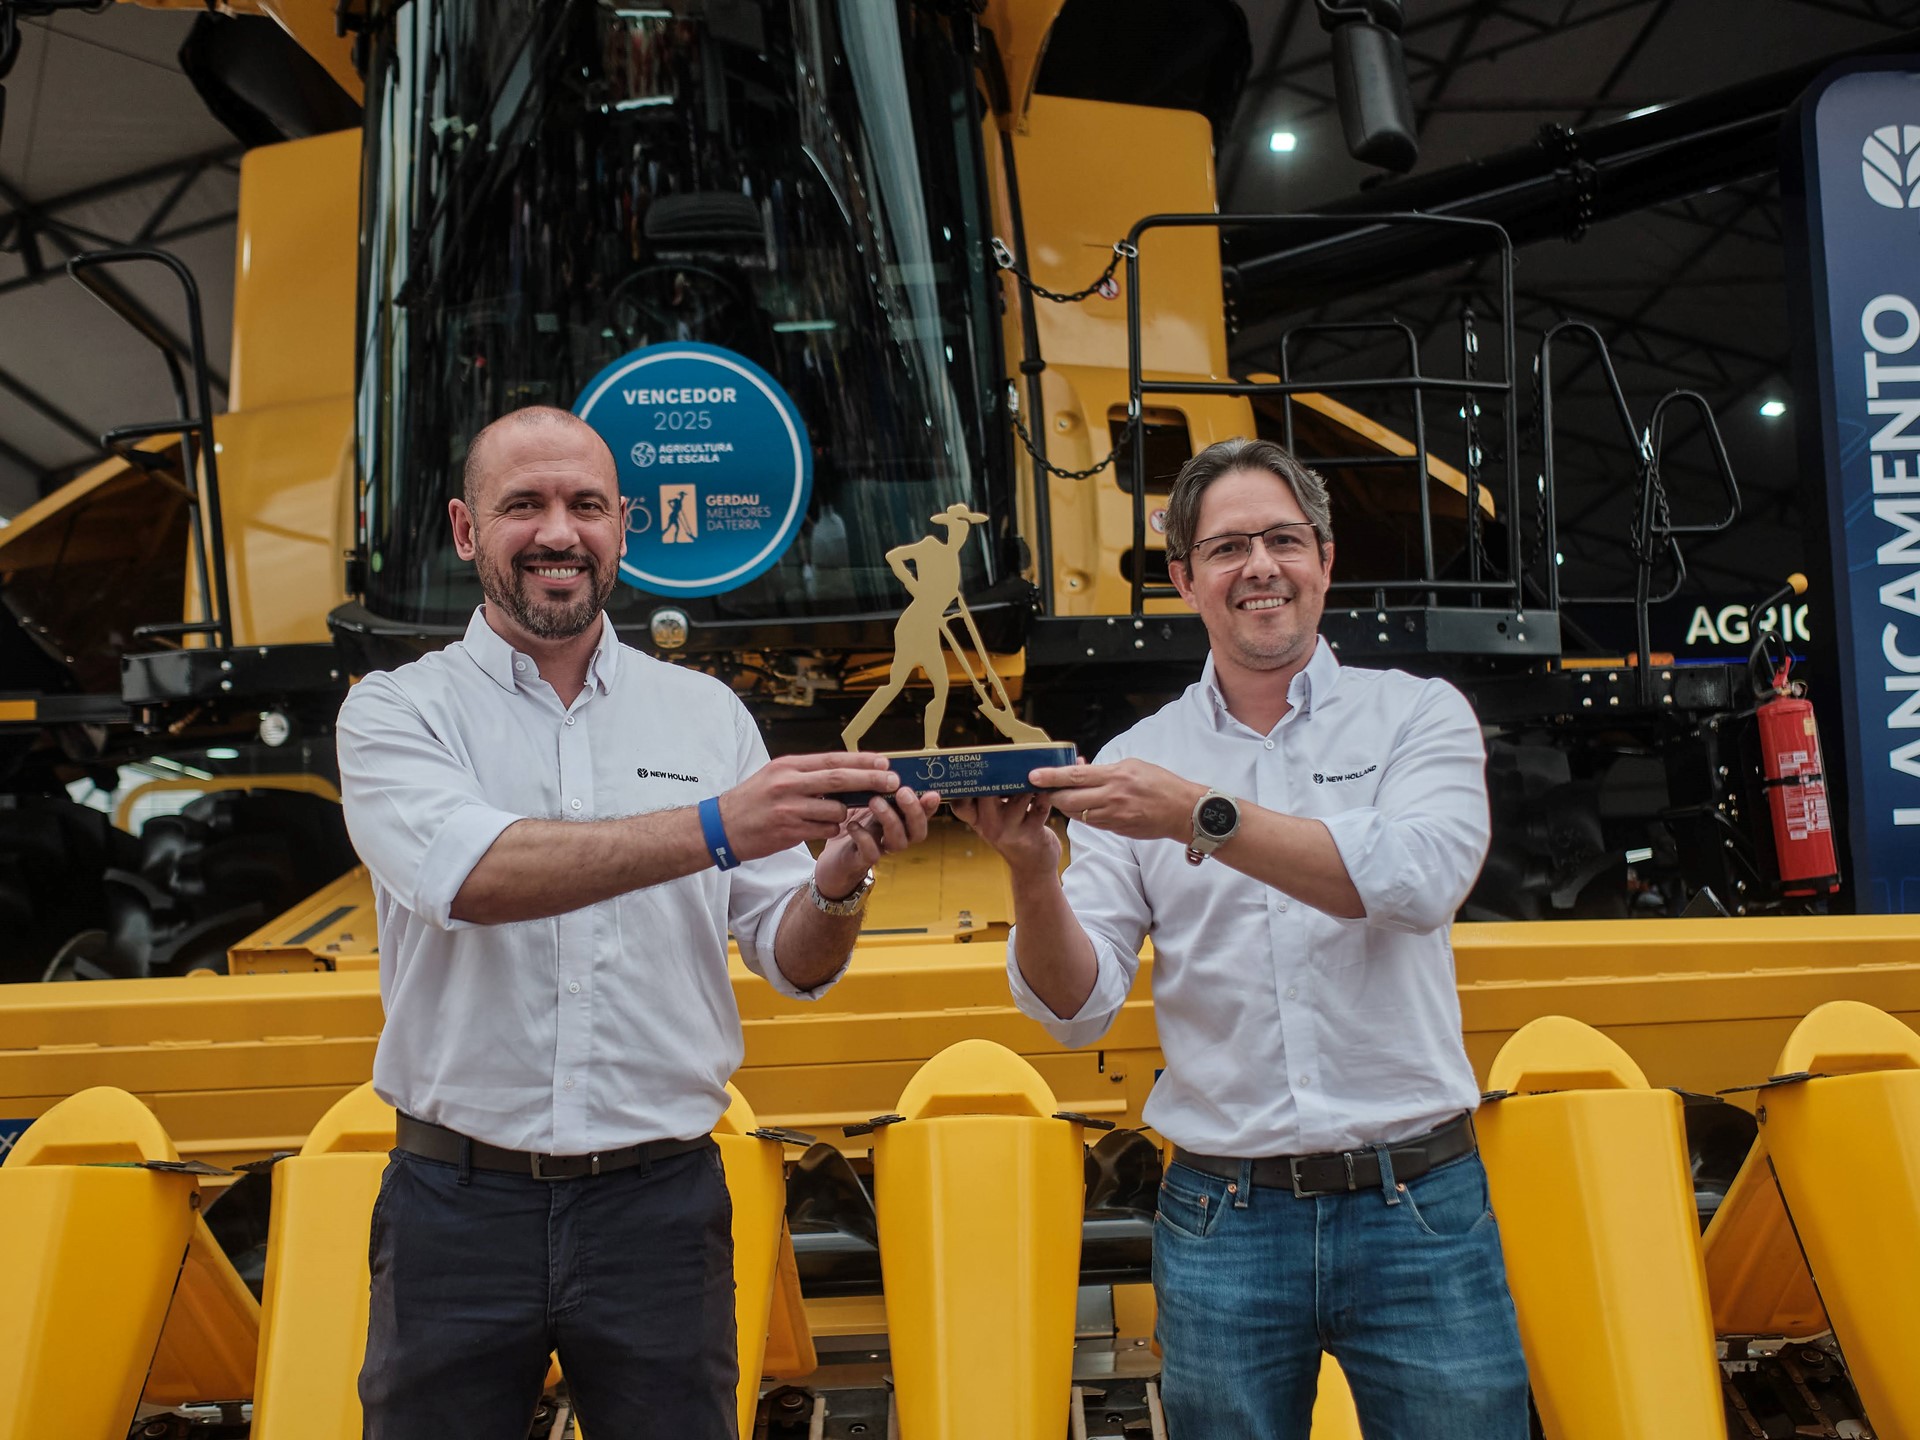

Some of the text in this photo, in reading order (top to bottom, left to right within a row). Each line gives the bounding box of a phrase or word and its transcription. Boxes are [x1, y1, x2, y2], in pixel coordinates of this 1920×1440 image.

[623, 388, 736, 405] VENCEDOR
[653, 410, 712, 431] 2025
[658, 442, 734, 453] AGRICULTURA
[658, 453, 720, 464] DE ESCALA
[705, 494, 760, 506] GERDAU
[705, 506, 772, 519] MELHORES
[706, 518, 761, 531] DA TERRA
[948, 754, 981, 763] GERDAU
[948, 761, 989, 770] MELHORES
[668, 773, 698, 782] HOLLAND
[960, 769, 983, 777] TERRA
[1326, 765, 1377, 783] NEW HOLLAND
[950, 785, 991, 794] AGRICULTURA
[1001, 783, 1025, 791] ESCALA
